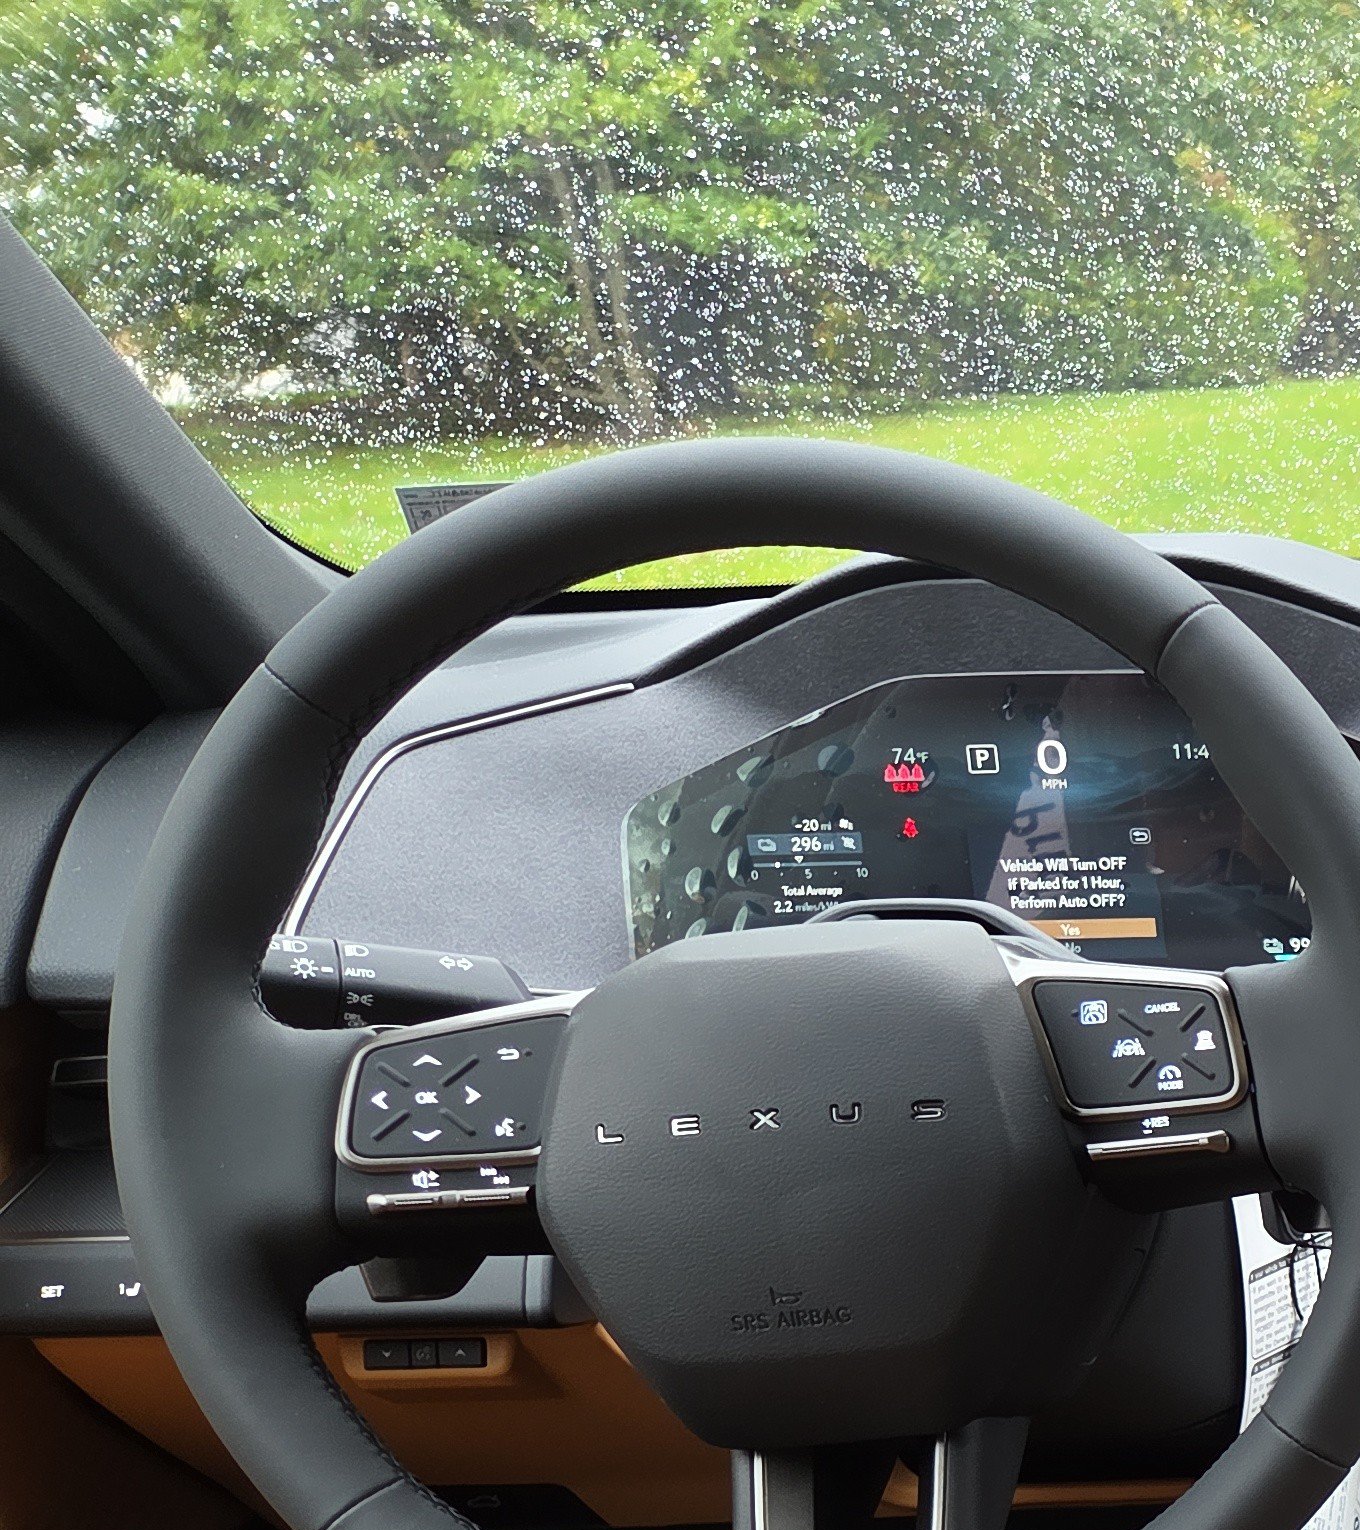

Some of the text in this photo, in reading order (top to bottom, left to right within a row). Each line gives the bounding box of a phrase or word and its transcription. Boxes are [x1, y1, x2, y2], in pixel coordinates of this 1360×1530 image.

[975, 750, 989, 768] P
[1037, 740, 1068, 775] 0
[1041, 778, 1068, 789] MPH
[791, 837, 822, 852] 296
[1000, 856, 1127, 872] Vehicle Will Turn OFF
[751, 867, 868, 880] 0 5 10
[1020, 875, 1125, 891] Parked for 1 Hour,
[781, 885, 843, 898] Total Average
[773, 900, 793, 913] 2.2
[1010, 893, 1126, 909] Perform Auto OFF?
[1060, 923, 1081, 936] Yes
[344, 967, 375, 978] AUTO
[1144, 1002, 1180, 1014] CANCEL
[415, 1091, 439, 1104] OK
[595, 1100, 946, 1144] LEXUS
[41, 1284, 64, 1298] SET
[731, 1307, 852, 1331] SRS AIRBAG
